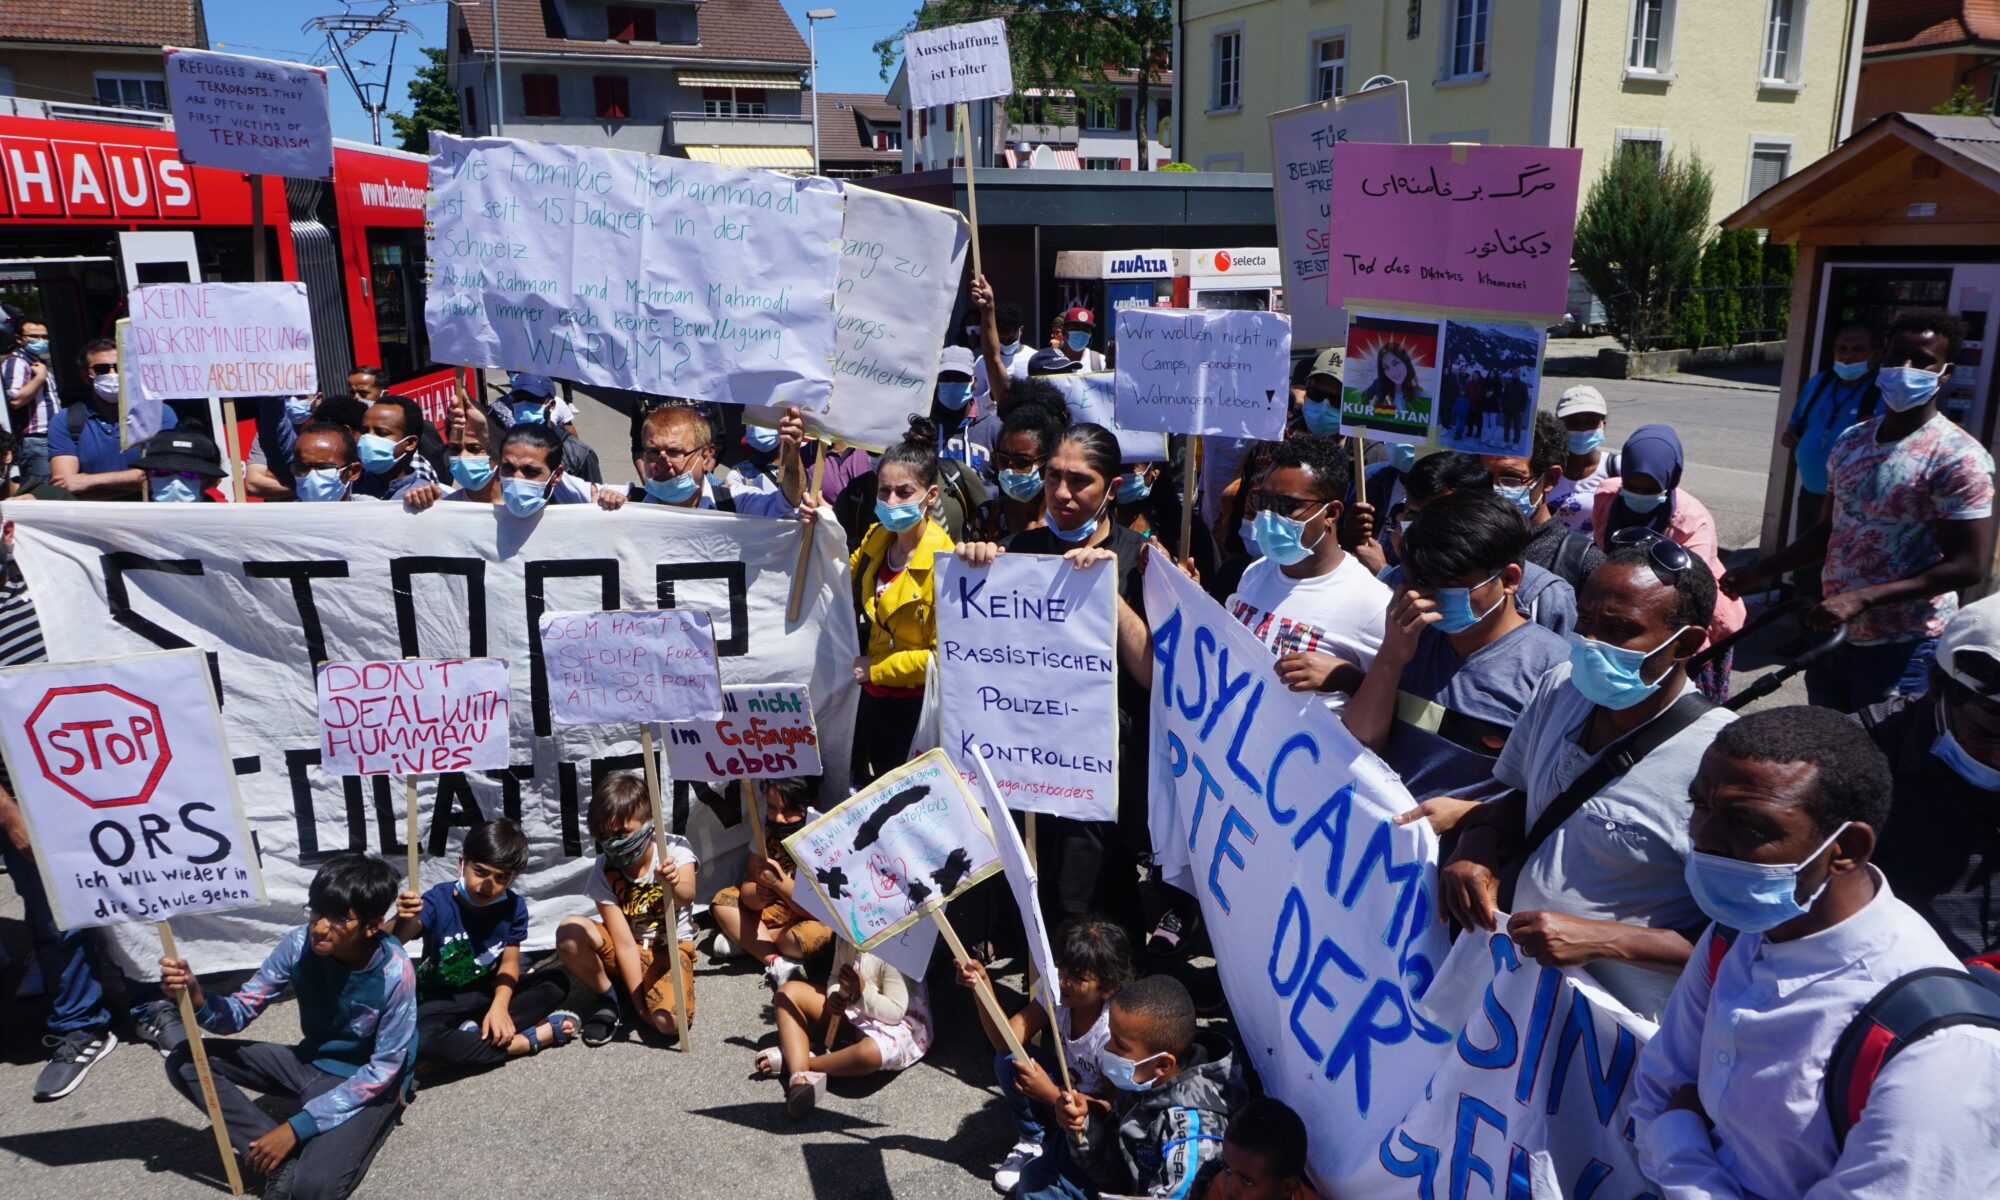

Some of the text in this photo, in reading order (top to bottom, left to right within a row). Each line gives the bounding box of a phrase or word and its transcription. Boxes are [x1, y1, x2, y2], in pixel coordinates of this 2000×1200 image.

[914, 35, 999, 58] Ausschaffung
[179, 59, 309, 86] REFUGEES ARE NOT
[931, 63, 987, 81] ist Folter
[185, 95, 286, 115] ARE OFTEN THE
[273, 89, 303, 100] THEY
[188, 112, 302, 132] FIRST VICTIMS OF
[208, 128, 310, 148] TERRORISM
[1311, 124, 1349, 151] FÜR
[9, 149, 191, 207] HAUS
[451, 151, 799, 215] Die Familie Mohammadi
[1489, 163, 1556, 198] مرگ
[441, 190, 749, 241] ist seit 15 Jahren in der
[894, 256, 928, 278] zu
[1110, 254, 1168, 273] LAVAZZA
[1232, 255, 1266, 266] selecta
[1343, 253, 1377, 276] Tod
[1384, 256, 1410, 274] des
[1420, 266, 1464, 282] Diktators
[140, 287, 217, 320] KEINE
[496, 270, 557, 293] Rahman
[580, 275, 608, 299] und
[626, 279, 694, 304] Mehrban
[707, 282, 793, 314] Mahmodi
[1113, 296, 1150, 311] LAVAZZA
[134, 326, 309, 356] DISKRIMINIERUNG
[441, 292, 782, 360] haben immer noch keine Bewilligung
[1123, 316, 1278, 348] Wir wollen nicht in
[171, 364, 206, 392] DER
[206, 358, 313, 392] ARBEITSSUCHE
[1142, 349, 1252, 376] Camps, sondern
[1133, 384, 1212, 414] Wohnungen
[958, 576, 1066, 623] KEINE
[612, 617, 646, 636] HAS
[665, 645, 709, 667] FORCE
[943, 640, 1113, 673] RASSISTISCHEN
[327, 661, 464, 692] DON'T
[563, 671, 712, 691] FULL DEPORT
[324, 695, 440, 728] DEAL
[567, 688, 653, 708] ATION
[748, 690, 802, 713] nicht
[977, 686, 1079, 716] POLIZEI-
[48, 715, 153, 776] STOP
[327, 723, 488, 757] HUMMAN
[670, 716, 816, 755] im Gefängnis
[961, 730, 1113, 774] KONTROLLEN
[89, 802, 232, 867] ORS
[75, 870, 109, 889] ich
[235, 867, 248, 881] in
[94, 887, 249, 917] die Schule gehen
[1268, 882, 1413, 1120] DER
[1457, 933, 1645, 1142] SIN
